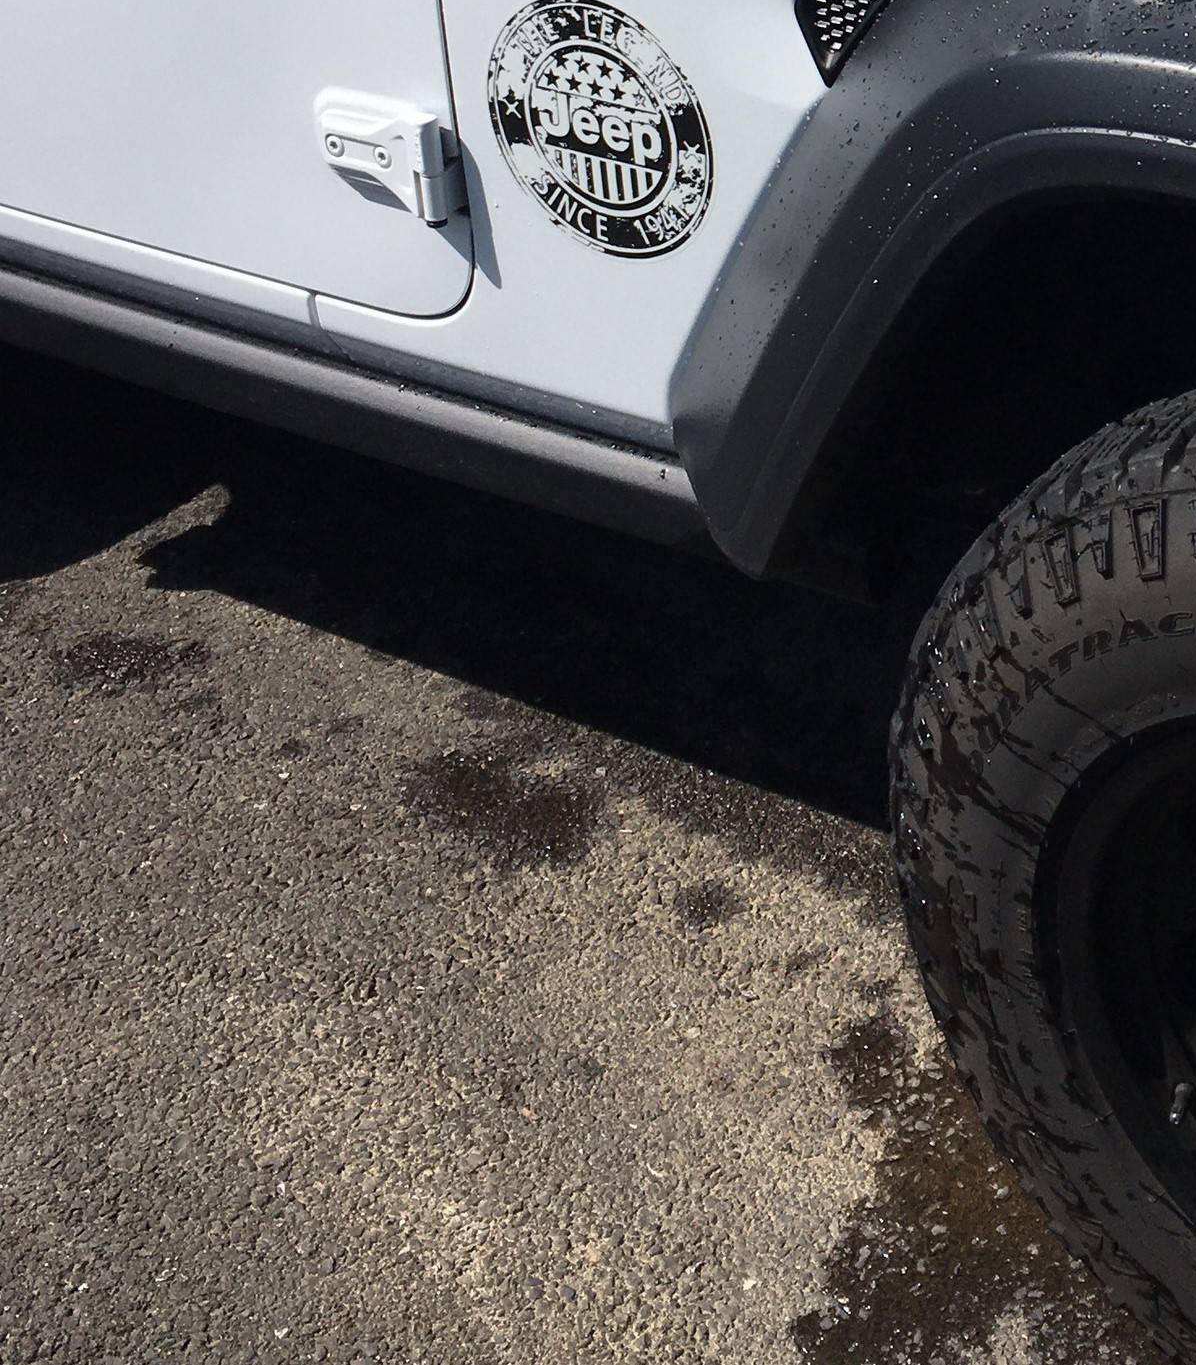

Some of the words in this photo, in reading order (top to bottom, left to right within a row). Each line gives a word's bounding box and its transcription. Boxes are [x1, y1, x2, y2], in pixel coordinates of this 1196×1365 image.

[511, 11, 561, 60] THE
[538, 90, 664, 166] Jeep
[530, 174, 610, 243] SINCE
